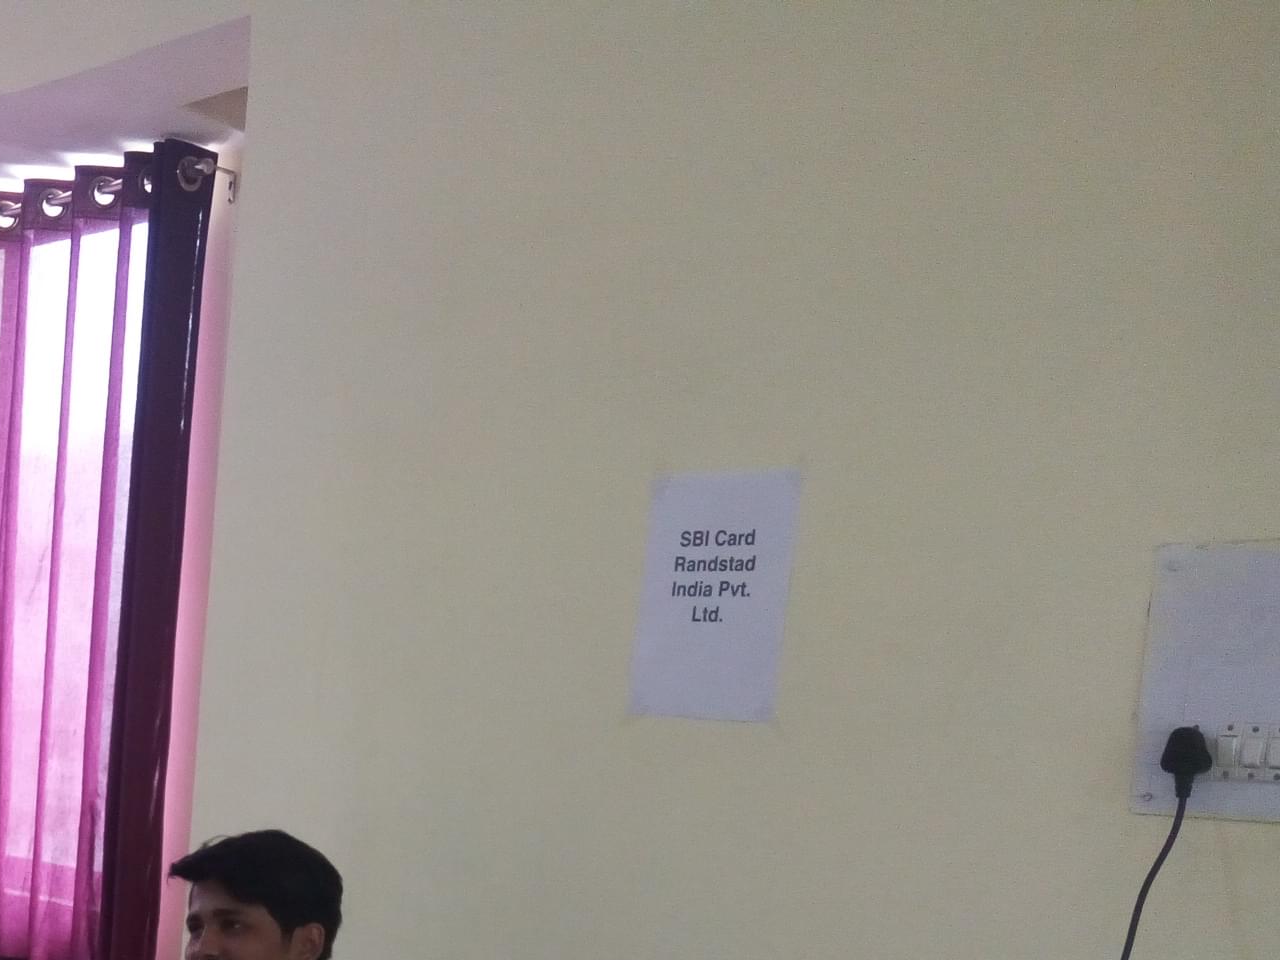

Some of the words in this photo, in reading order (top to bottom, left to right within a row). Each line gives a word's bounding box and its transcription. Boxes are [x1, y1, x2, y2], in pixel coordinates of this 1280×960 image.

[680, 530, 709, 547] SBI
[715, 529, 756, 546] Card
[674, 556, 756, 572] Randstad
[672, 581, 713, 597] India
[718, 581, 750, 597] Pvt.
[691, 606, 723, 622] Ltd.
